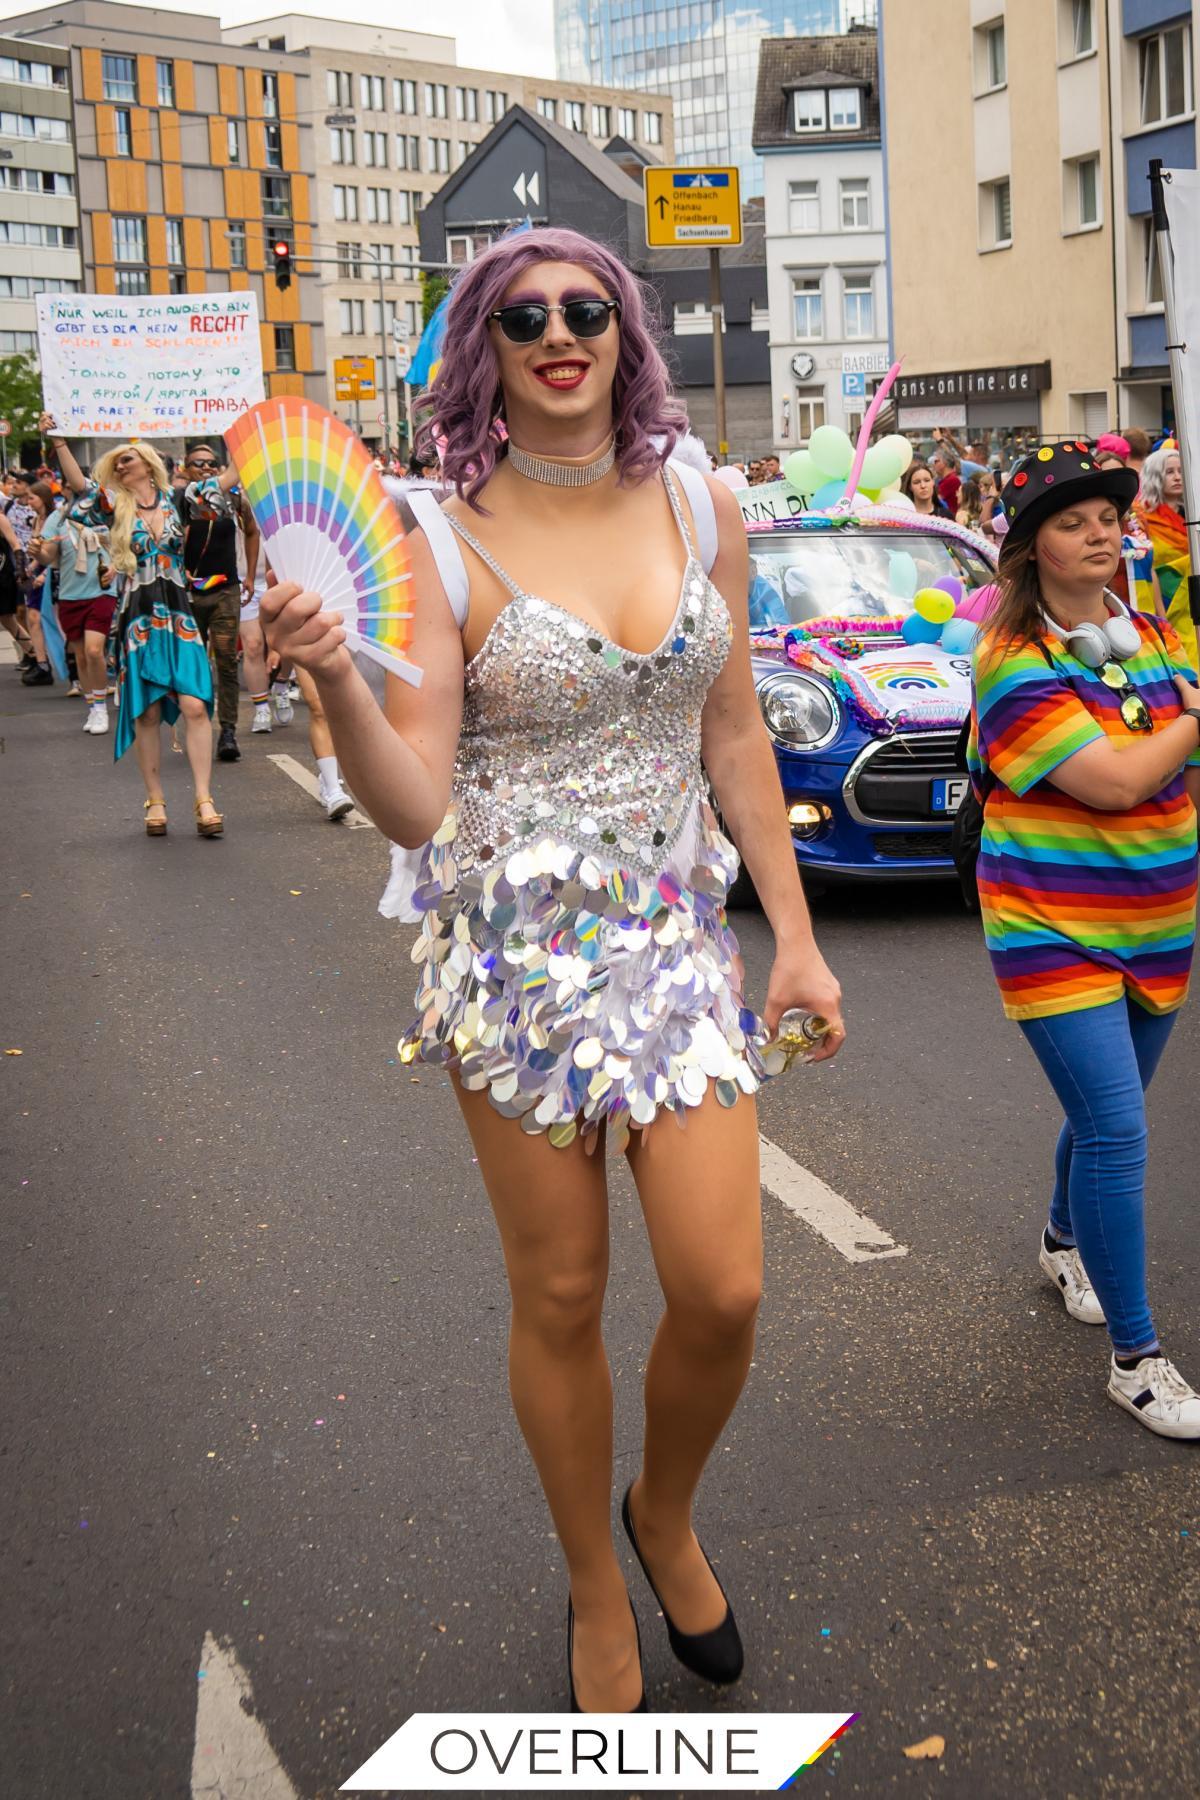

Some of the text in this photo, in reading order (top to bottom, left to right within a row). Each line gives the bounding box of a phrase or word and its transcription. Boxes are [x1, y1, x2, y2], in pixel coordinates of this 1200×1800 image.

[672, 191, 718, 200] Offenbach
[673, 203, 702, 211] Hanau
[673, 214, 718, 223] Friedberg
[677, 228, 729, 237] Sachsenhausen
[57, 301, 250, 319] NUR WEIL ICH ANDERS BIN
[55, 323, 87, 334] GIBT
[92, 325, 109, 334] ES
[190, 314, 249, 333] RECHT
[215, 366, 241, 376] ЧТО
[845, 375, 859, 394] P
[876, 373, 1028, 397] lans-online.de
[71, 405, 87, 415] НЕ
[193, 398, 250, 414] ПРАВА
